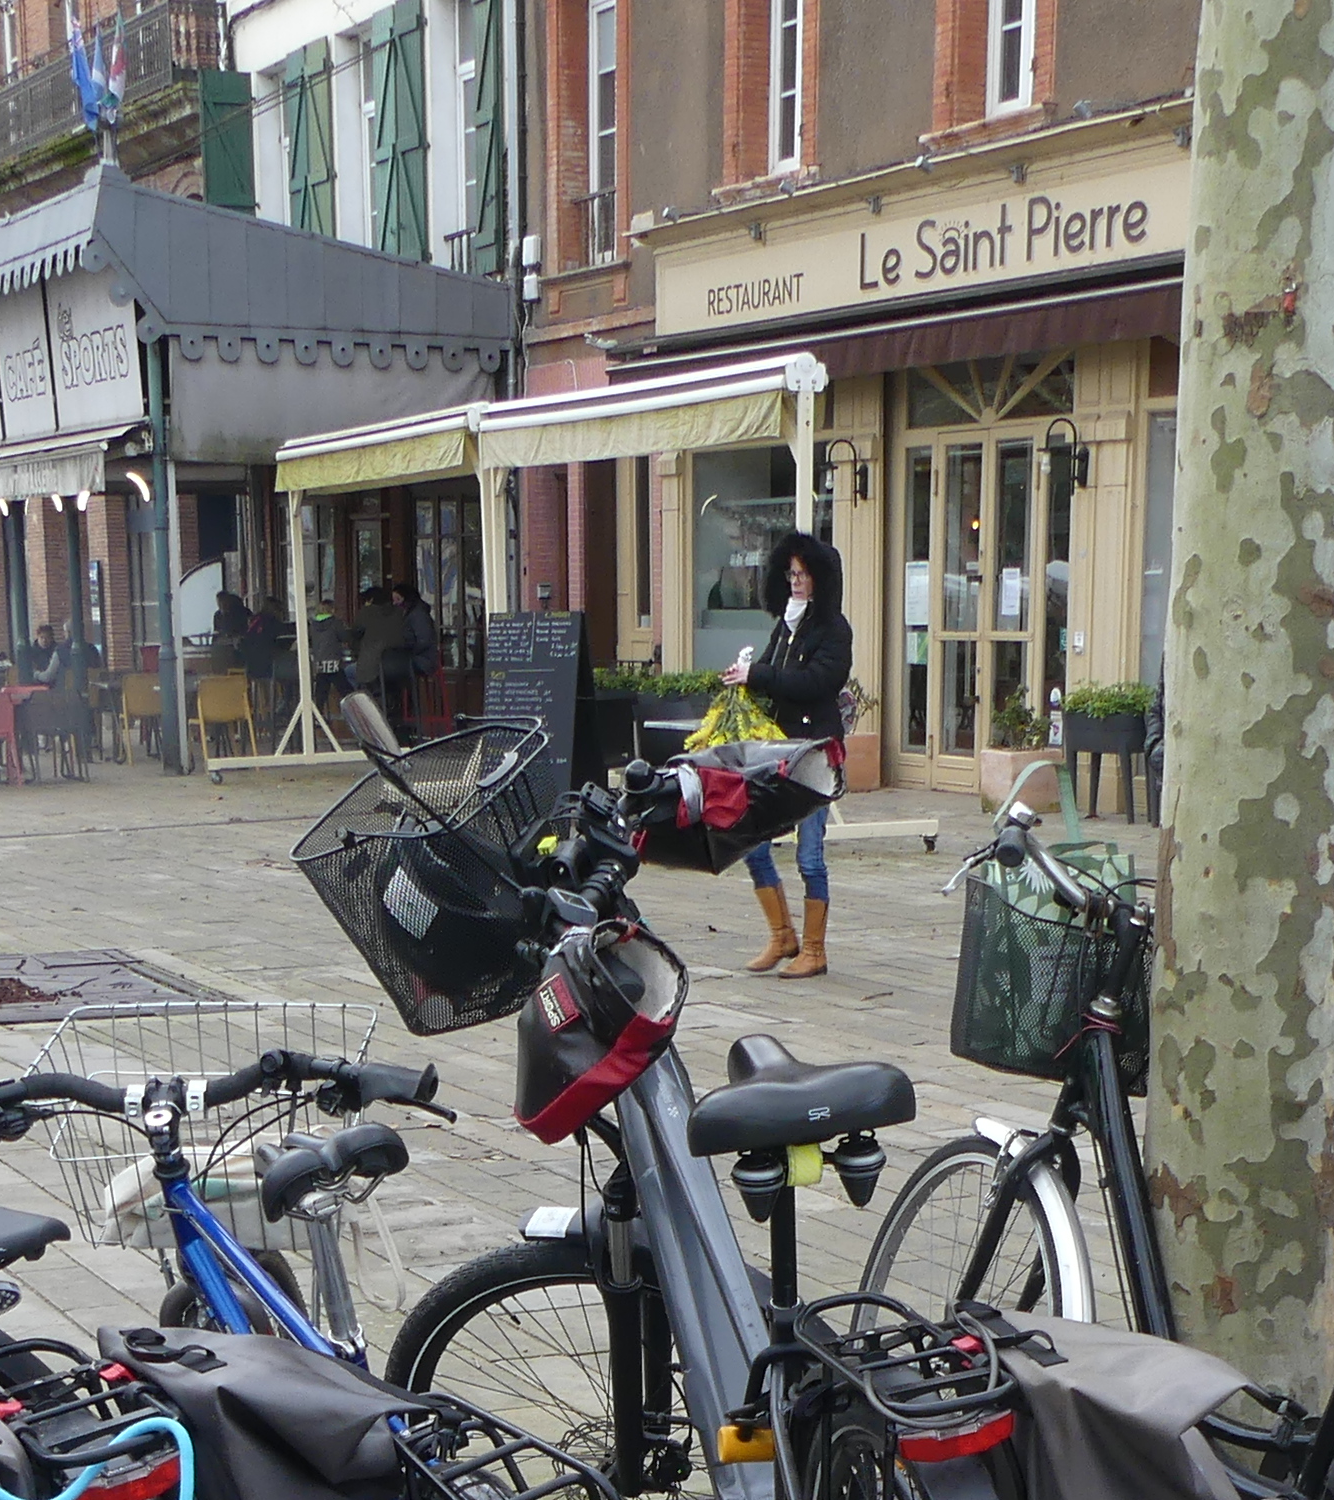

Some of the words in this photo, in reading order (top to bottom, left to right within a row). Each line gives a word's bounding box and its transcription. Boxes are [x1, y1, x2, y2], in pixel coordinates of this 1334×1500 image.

[859, 231, 902, 293] Le
[914, 203, 1013, 280] Saint
[1026, 195, 1150, 262] Pierre
[706, 272, 805, 318] RESTAURANT
[5, 337, 47, 403] CAFÉ
[60, 324, 130, 391] SPORTS
[539, 989, 561, 1028] SPORT
